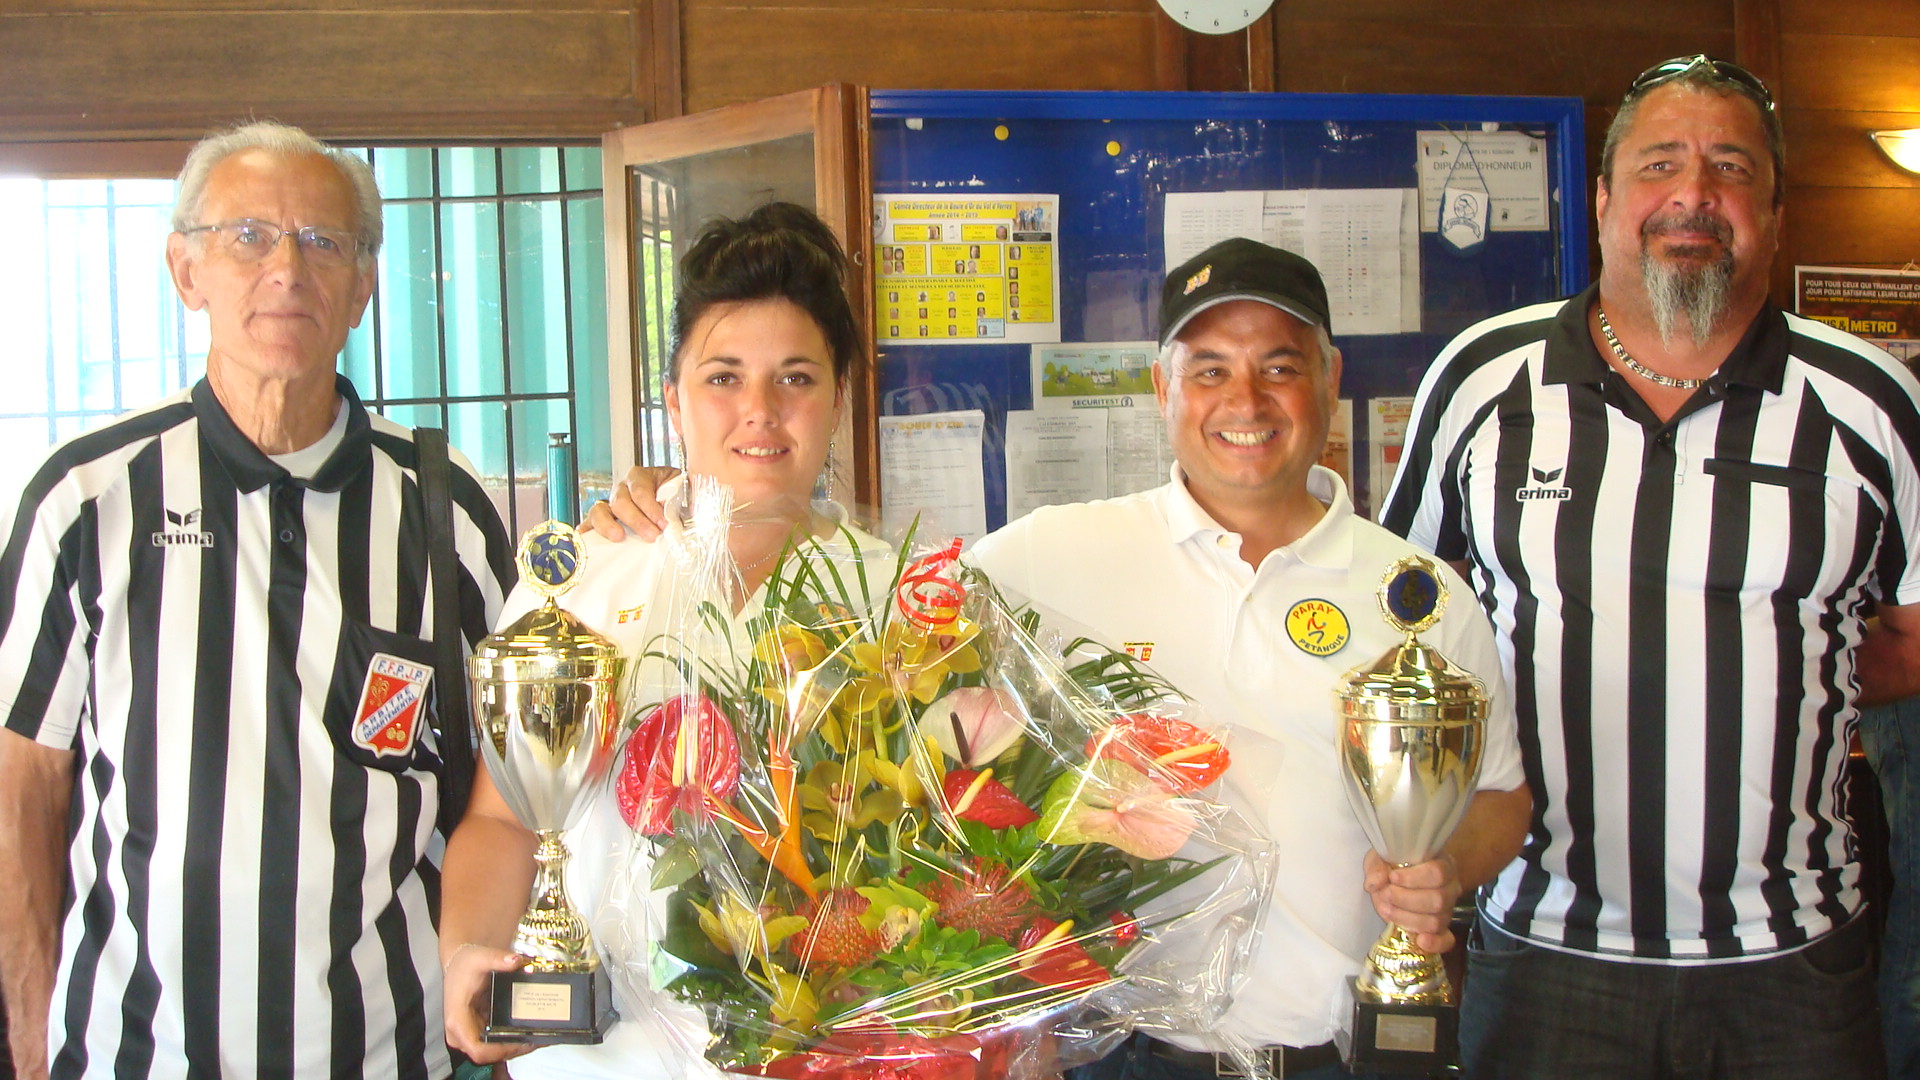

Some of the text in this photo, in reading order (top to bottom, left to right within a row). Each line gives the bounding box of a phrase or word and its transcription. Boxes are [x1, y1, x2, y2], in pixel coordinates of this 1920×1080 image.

[1184, 11, 1189, 20] 7
[1477, 161, 1532, 170] D'HONNEUR
[1805, 280, 1823, 288] POUR
[1824, 280, 1841, 288] TOUS
[1842, 281, 1859, 289] CEUX
[1860, 282, 1872, 290] QUI
[1872, 282, 1913, 290] TRAVAILLENT
[1805, 288, 1823, 296] JOUR
[1824, 288, 1842, 296] POUR
[1842, 289, 1876, 298] SATISFAIRE
[1877, 290, 1898, 299] LEURS
[1851, 320, 1897, 333] METRO
[1072, 398, 1119, 407] SECURITEST
[1518, 487, 1570, 500] erima
[153, 530, 213, 546] erima
[1292, 602, 1334, 620] PARAY
[1299, 634, 1345, 653] PETANQUE
[362, 686, 411, 731] ARBITRE
[364, 694, 416, 740] DEPARTEMENTAL
